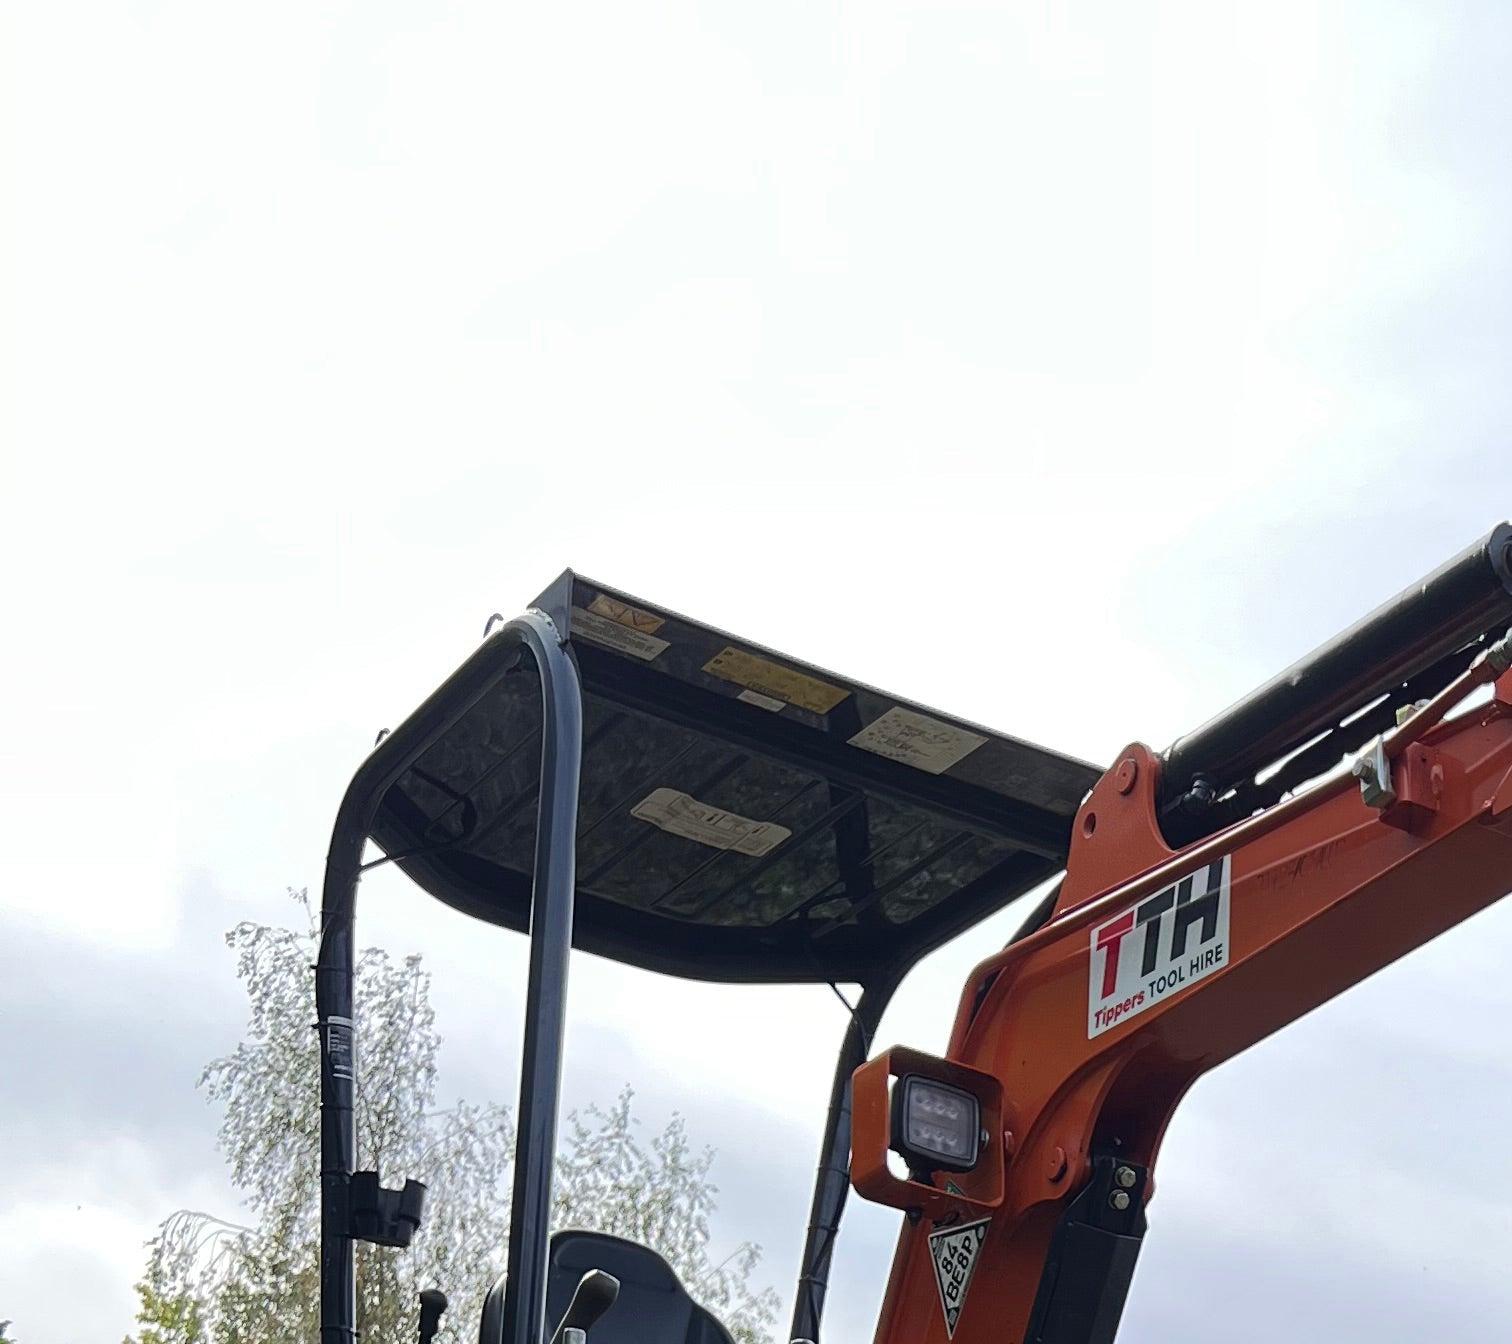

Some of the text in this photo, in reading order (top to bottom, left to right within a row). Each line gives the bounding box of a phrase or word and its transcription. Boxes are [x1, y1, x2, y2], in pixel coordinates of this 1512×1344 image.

[1096, 856, 1223, 1000] TTH
[1095, 944, 1223, 1028] Tippers TOOL HIRE
[942, 1242, 958, 1274] 84
[946, 1236, 974, 1302] BE8P
